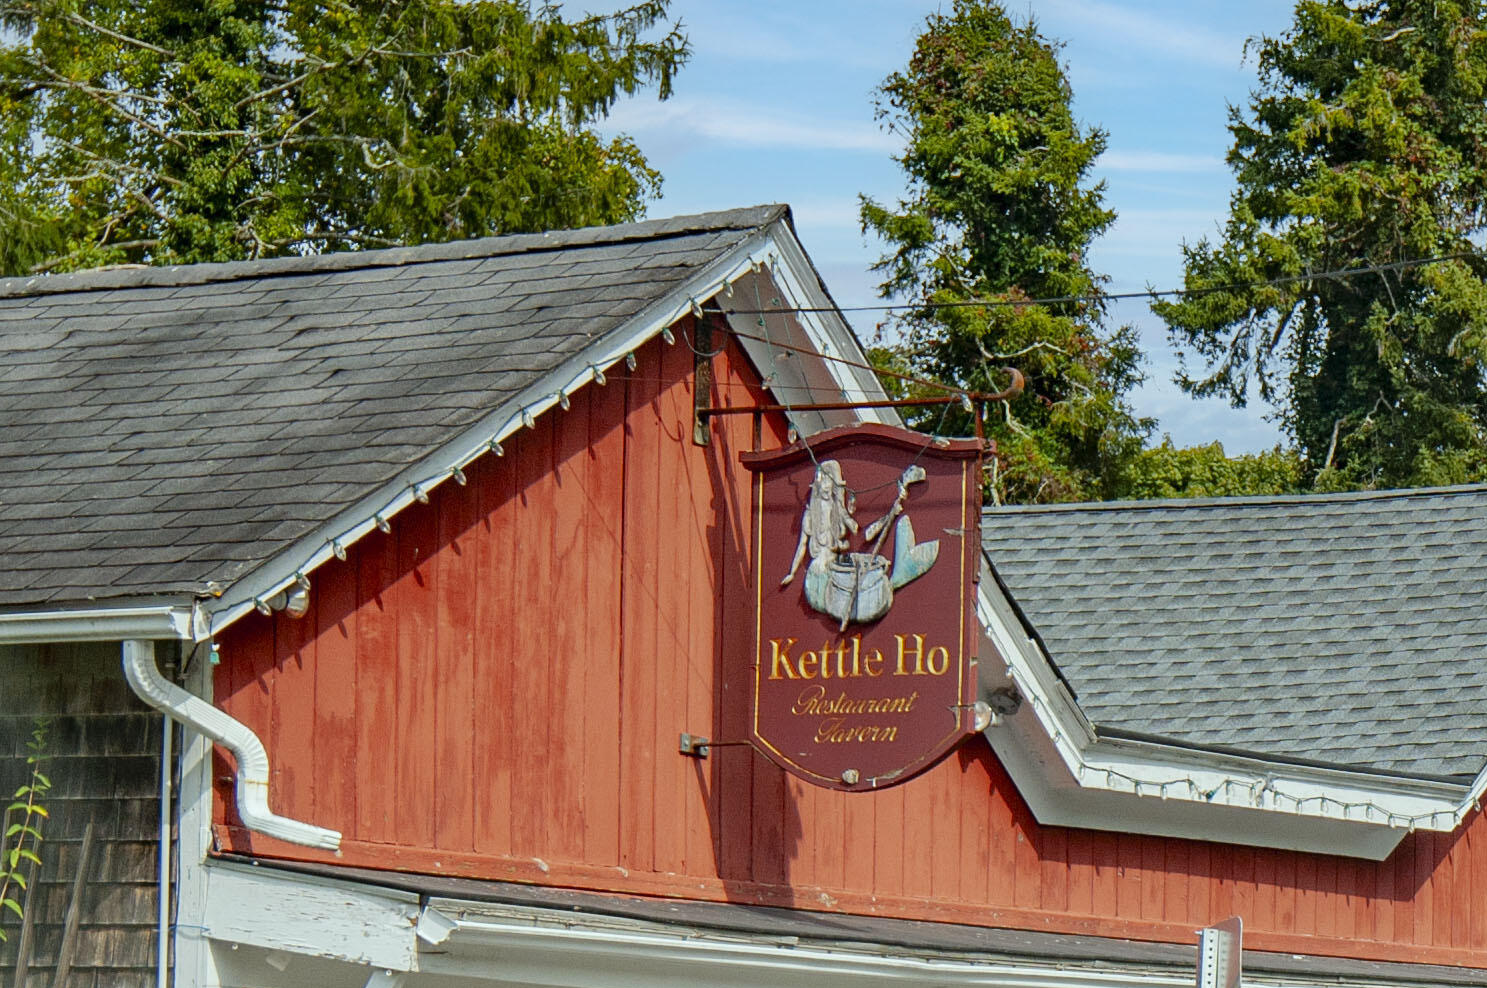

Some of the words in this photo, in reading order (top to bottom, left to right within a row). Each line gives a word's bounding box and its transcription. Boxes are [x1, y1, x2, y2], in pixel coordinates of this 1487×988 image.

[768, 633, 884, 680] Kettle
[893, 632, 949, 676] Ho
[791, 684, 920, 716] Restaurant
[814, 717, 898, 744] Tavern
